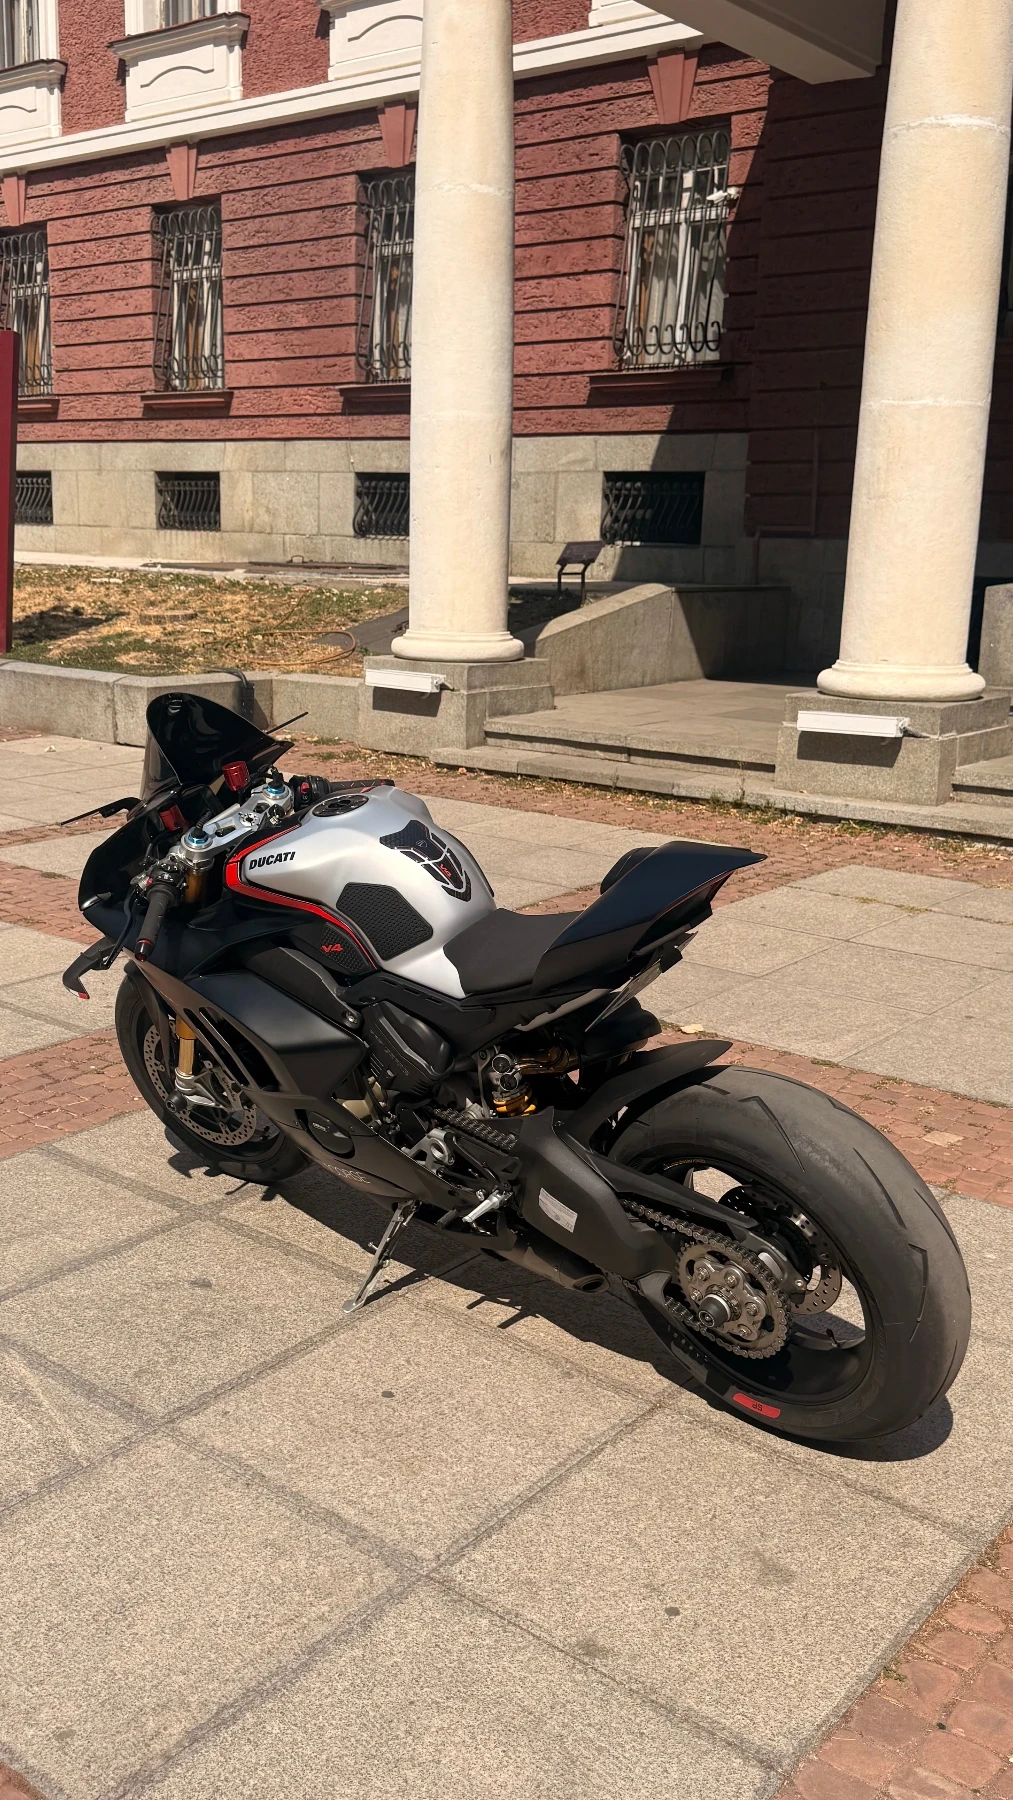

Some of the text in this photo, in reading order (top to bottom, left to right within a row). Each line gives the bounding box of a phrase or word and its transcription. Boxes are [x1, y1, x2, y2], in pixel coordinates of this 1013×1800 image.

[249, 851, 296, 870] DUCATI
[321, 943, 343, 953] V4
[751, 1402, 763, 1412] SP
